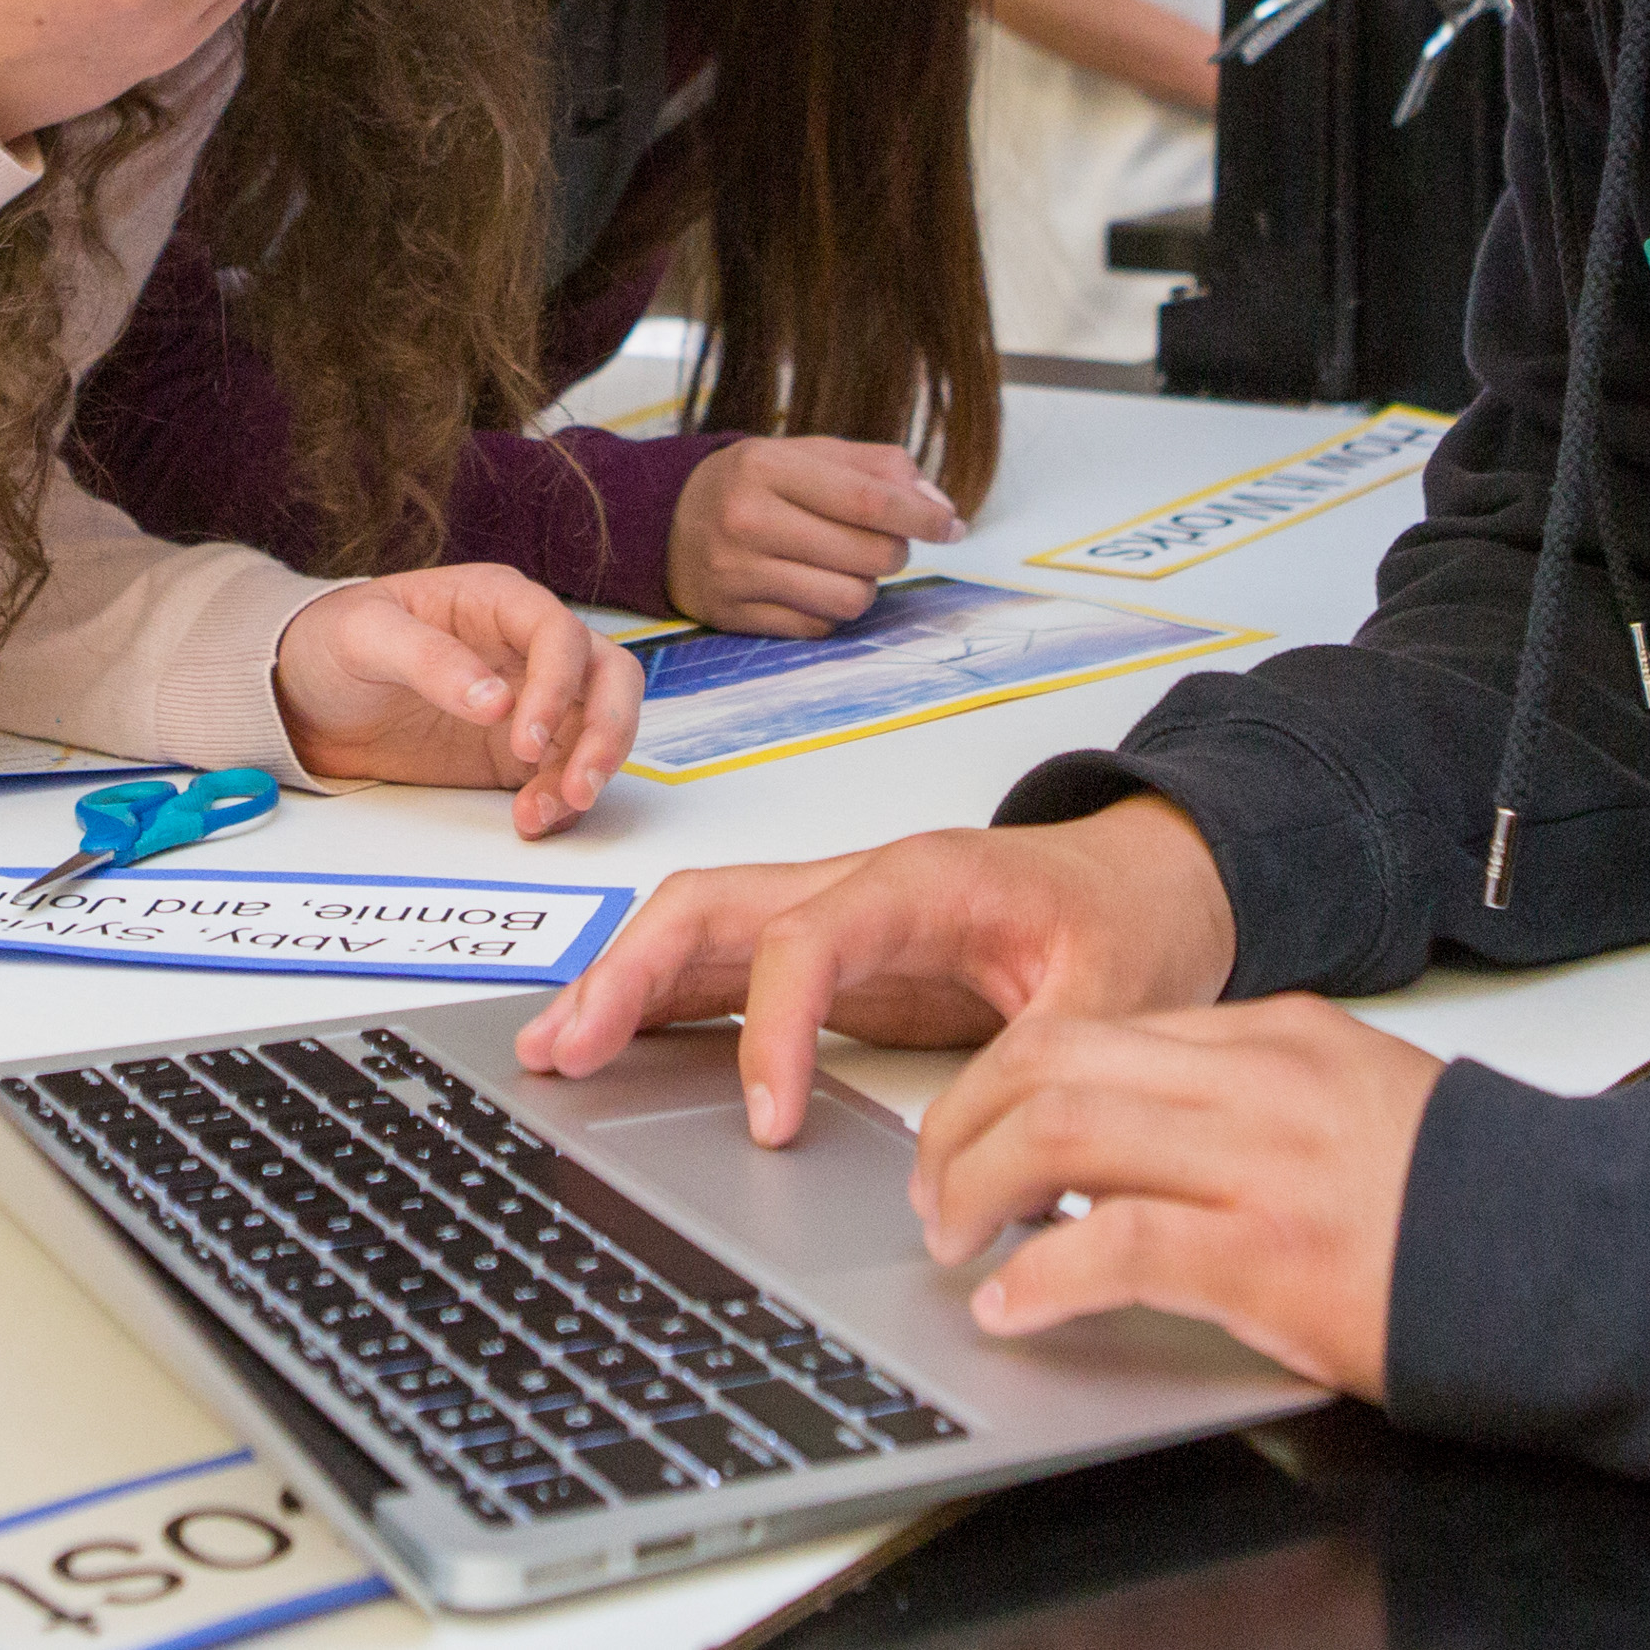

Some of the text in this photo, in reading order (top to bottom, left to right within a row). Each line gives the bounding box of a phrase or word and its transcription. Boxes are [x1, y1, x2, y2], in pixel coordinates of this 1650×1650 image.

[1305, 421, 1447, 475] How
[1087, 492, 1318, 562] Works
[141, 897, 272, 917] and
[301, 898, 549, 932] Bonnie,
[198, 926, 388, 953] Abby,
[408, 934, 518, 958] By:
